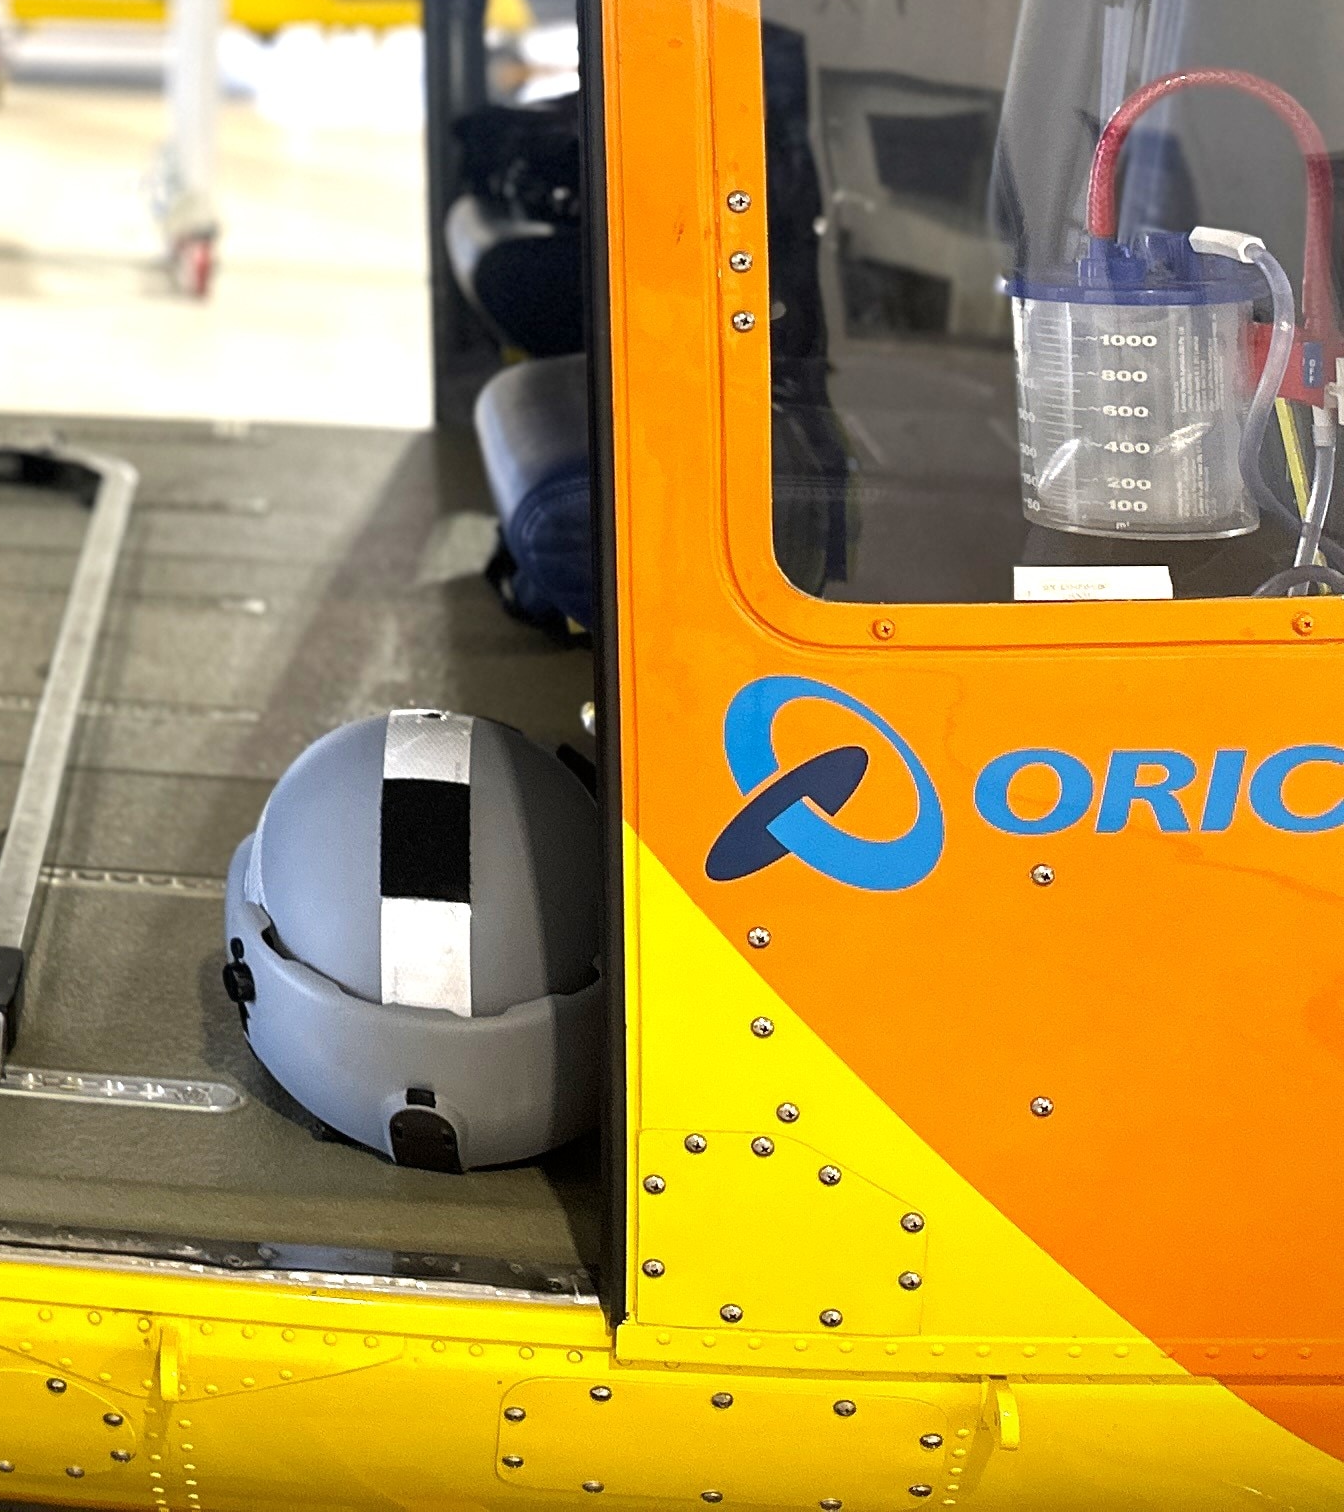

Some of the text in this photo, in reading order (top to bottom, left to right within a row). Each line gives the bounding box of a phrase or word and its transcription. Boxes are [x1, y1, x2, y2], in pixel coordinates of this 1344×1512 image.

[1100, 334, 1158, 348] 1000
[1101, 370, 1148, 383] 800
[1102, 406, 1150, 419] 600
[1104, 442, 1151, 455] 400
[1107, 477, 1152, 490] 200
[1108, 500, 1149, 512] 100
[973, 743, 1344, 835] ORIC
